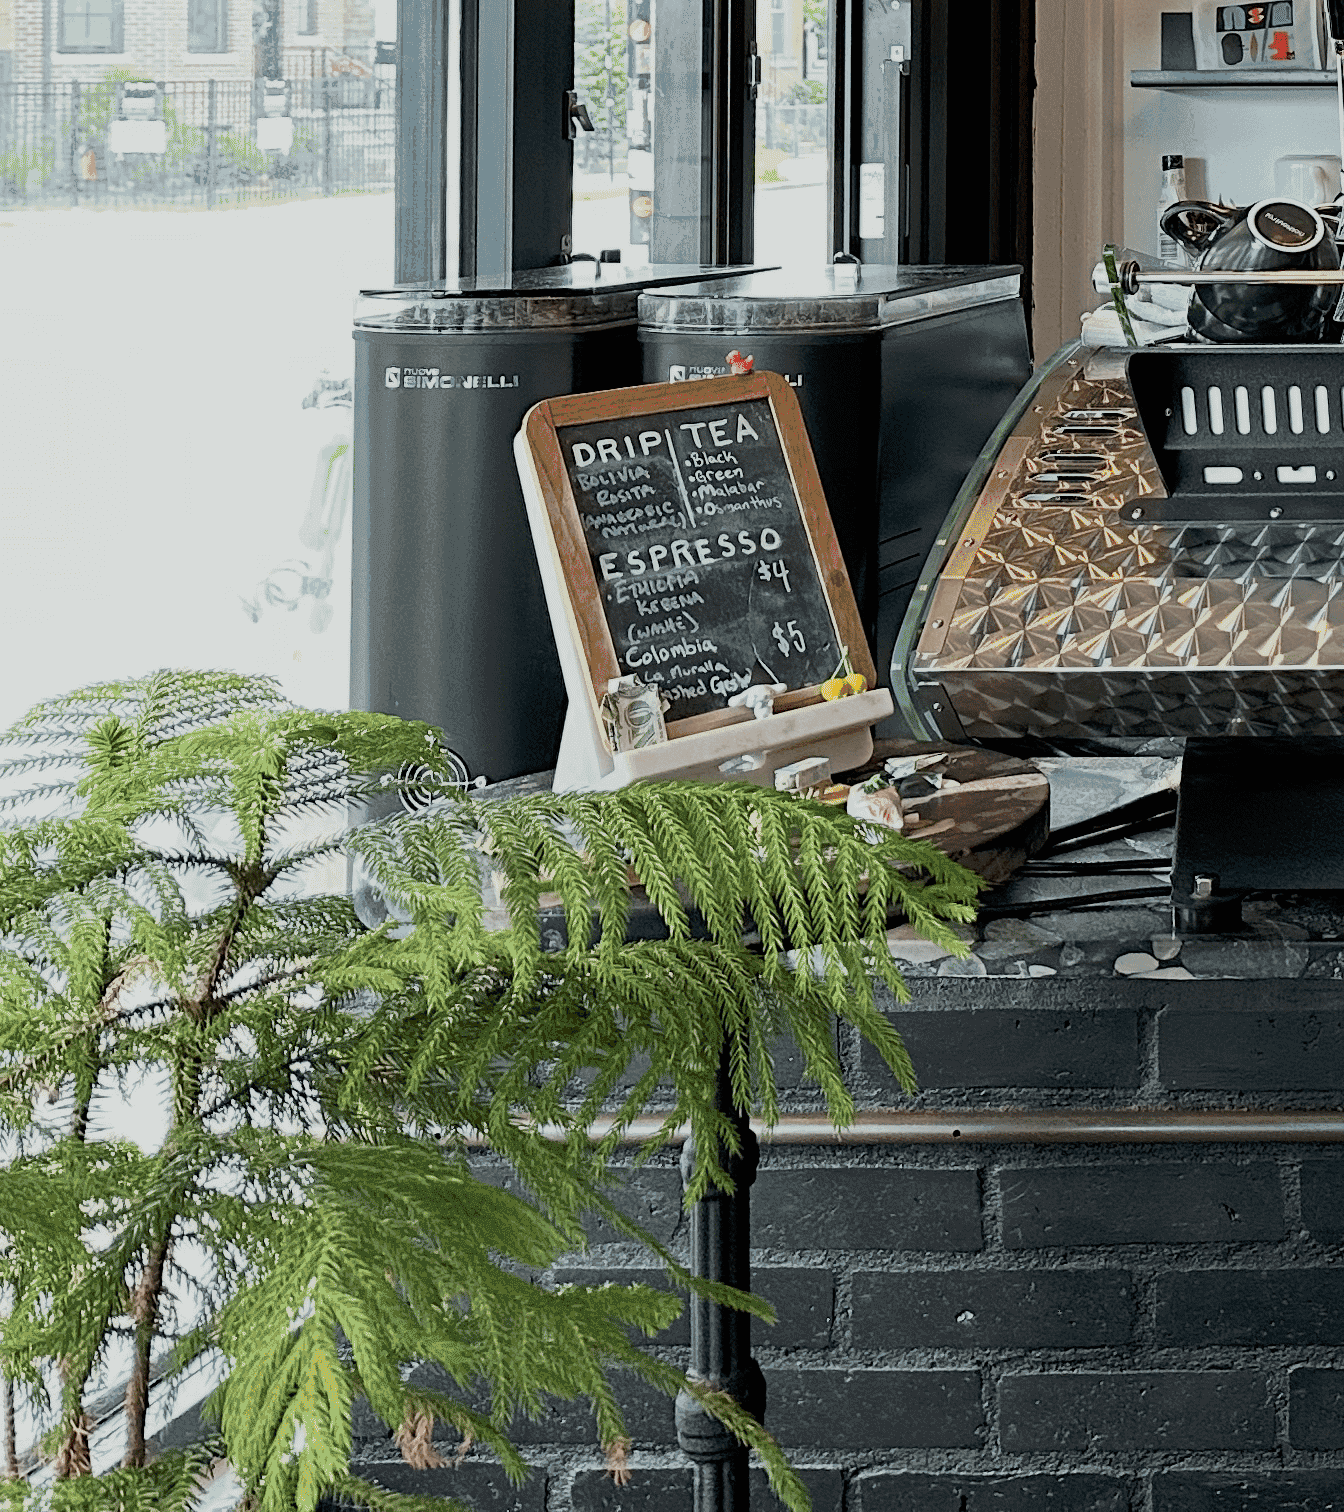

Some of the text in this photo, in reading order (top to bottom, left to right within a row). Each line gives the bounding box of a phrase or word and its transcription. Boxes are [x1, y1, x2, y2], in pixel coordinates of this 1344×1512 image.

[680, 414, 759, 449] TEA
[572, 430, 662, 467] DRIP
[690, 450, 738, 467] Black
[577, 466, 650, 492] BOLIVIA
[694, 468, 744, 484] Green
[698, 480, 765, 500] Malabar
[703, 495, 782, 516] Osmanthus
[599, 527, 783, 581] ESPRESSO
[614, 570, 700, 604] ETHIOPIA
[757, 559, 792, 593] $4
[625, 637, 718, 668] Colombia
[772, 620, 806, 657] $5
